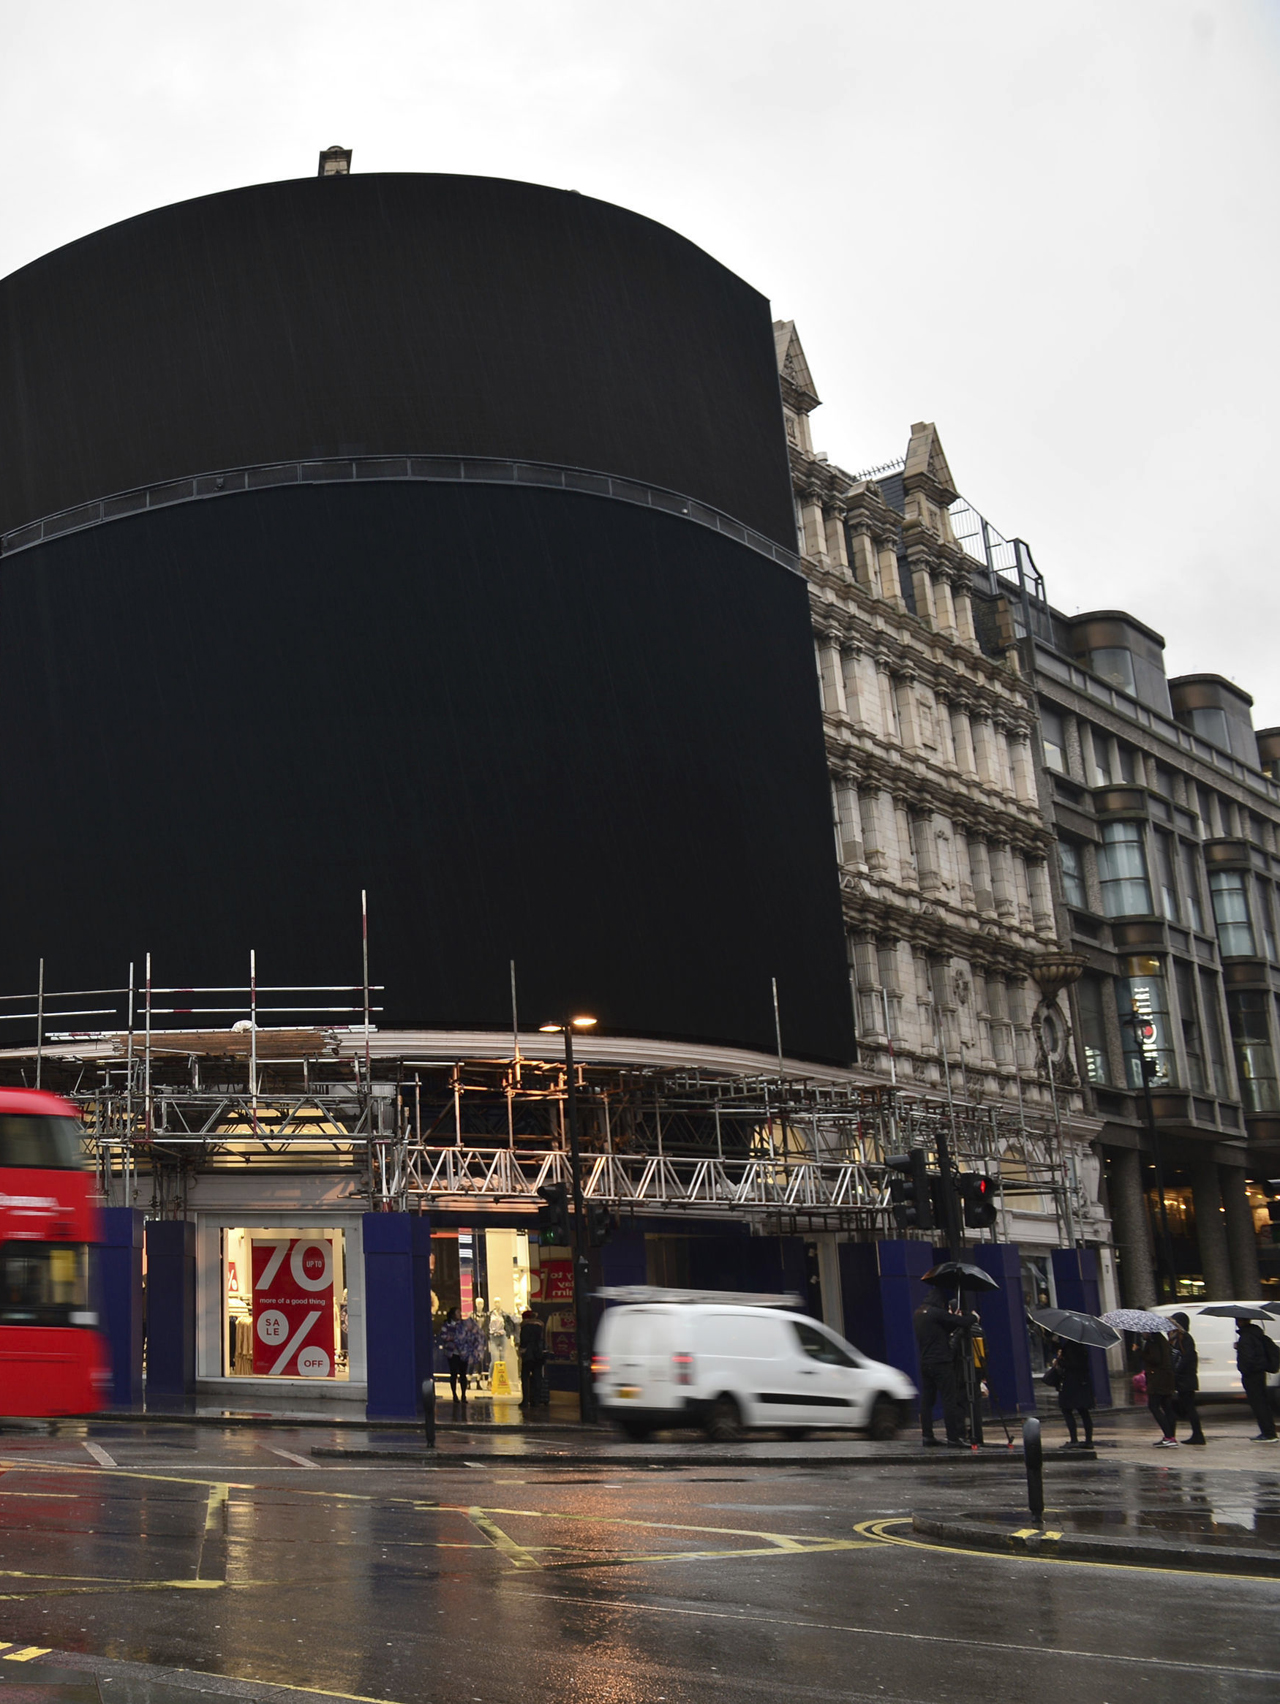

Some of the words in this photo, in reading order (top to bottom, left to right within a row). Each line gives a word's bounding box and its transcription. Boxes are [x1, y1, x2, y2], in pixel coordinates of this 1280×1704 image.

[252, 1239, 333, 1292] 70
[291, 1298, 307, 1306] good
[309, 1298, 326, 1306] thing
[303, 1359, 324, 1368] OFF
